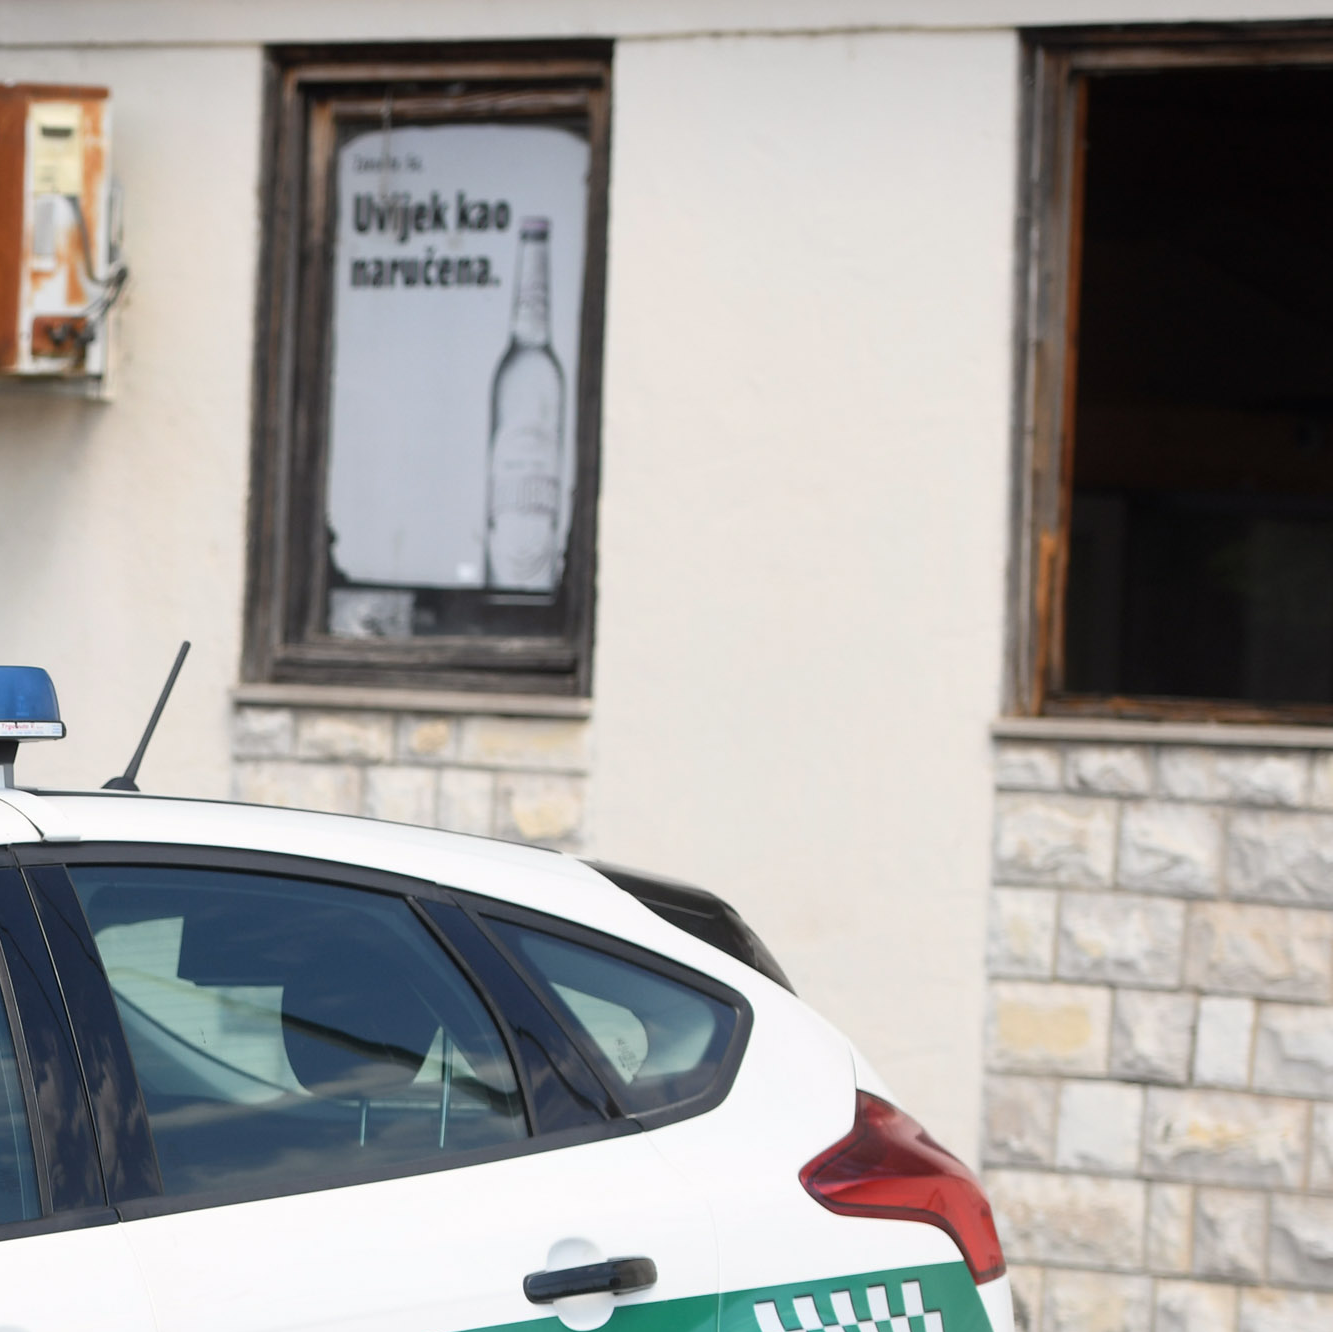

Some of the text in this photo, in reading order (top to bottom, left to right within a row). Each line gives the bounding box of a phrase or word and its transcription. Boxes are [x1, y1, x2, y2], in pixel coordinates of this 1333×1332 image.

[354, 189, 510, 243] Uvijek kao
[351, 246, 501, 288] naručena.
